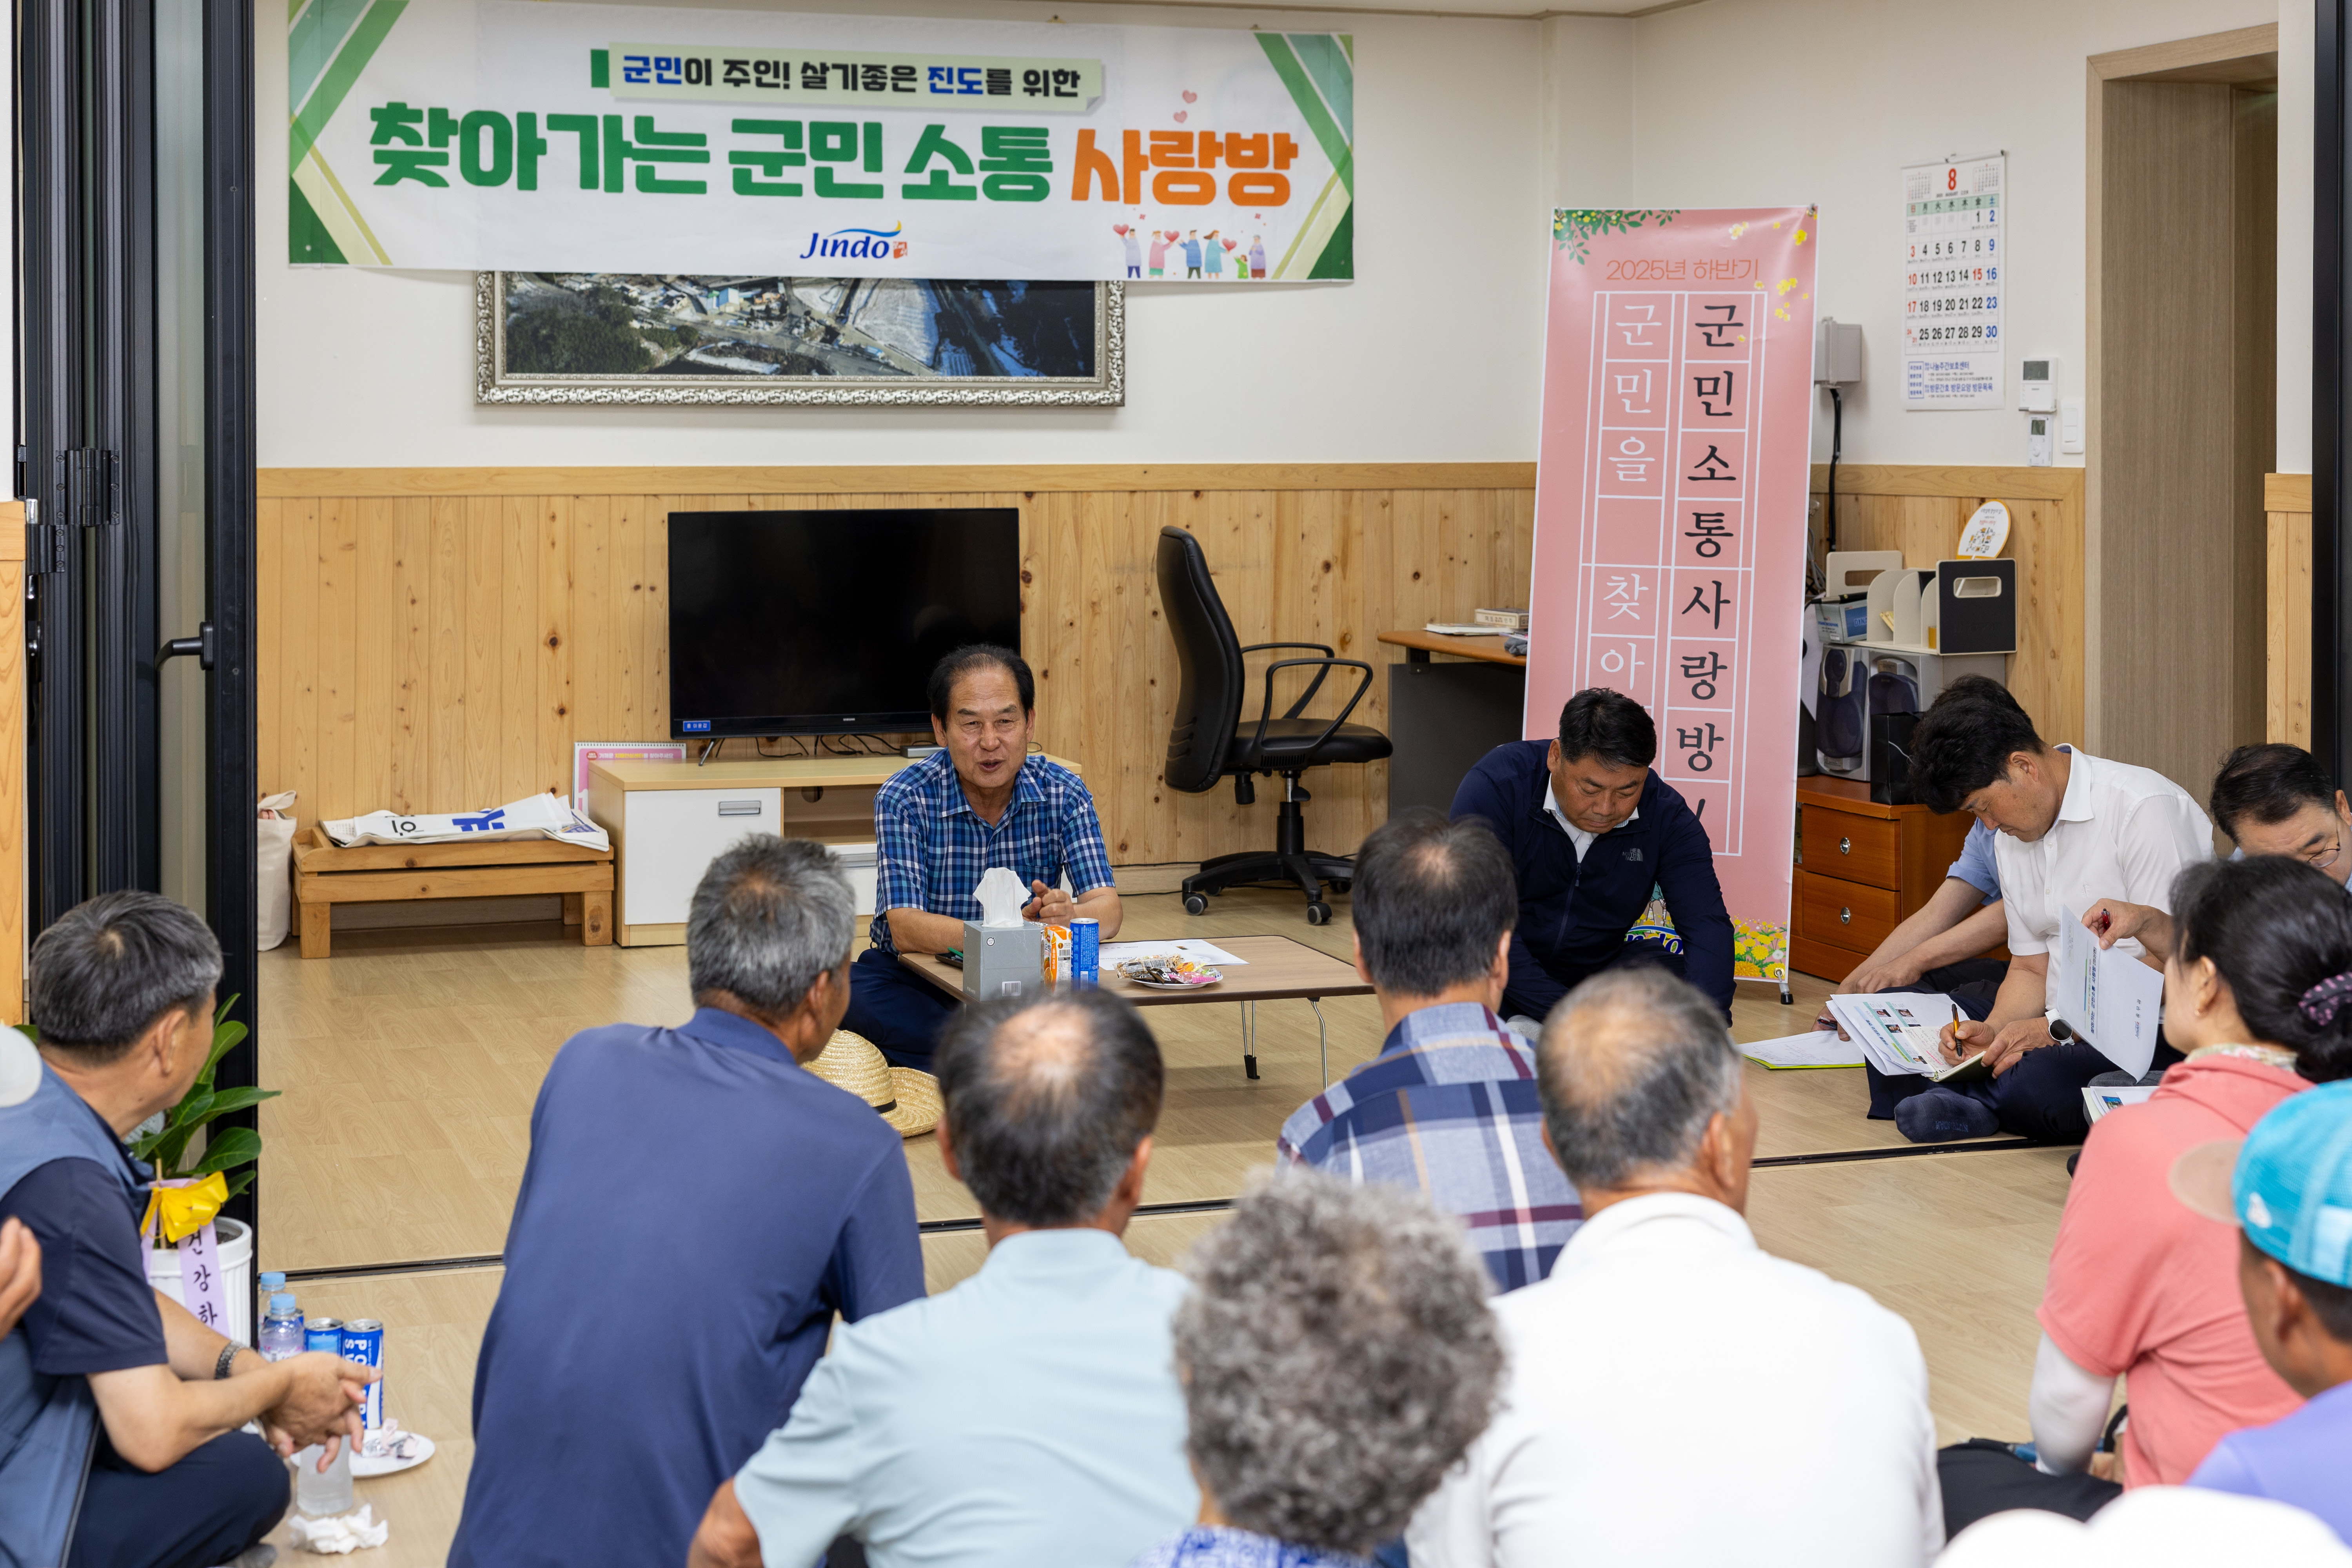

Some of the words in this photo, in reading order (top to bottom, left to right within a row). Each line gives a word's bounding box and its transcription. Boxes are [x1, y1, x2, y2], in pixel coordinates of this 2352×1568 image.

[623, 56, 712, 86] 군민이
[722, 59, 790, 90] 주인!
[800, 61, 918, 93] 살기좋은
[927, 66, 1013, 96] 진도를
[1023, 68, 1081, 98] 위한
[370, 102, 711, 195] 찾아가는
[728, 118, 884, 199] 군민
[901, 124, 1053, 202] 소통
[1071, 128, 1299, 207] 사랑방
[1948, 168, 1956, 191] 8
[1976, 211, 1980, 222] 1
[1990, 210, 1995, 222] 2
[800, 232, 889, 259] Jindo
[1911, 246, 1915, 257] 3
[1923, 245, 1927, 255] 4
[1936, 243, 1940, 255] 5
[1948, 242, 1953, 254] 6
[1962, 240, 1966, 252] 7
[1975, 240, 1980, 252] 8
[1989, 239, 1994, 251] 9
[1606, 260, 1686, 280] 2025년
[1693, 259, 1759, 280] 하반기
[1909, 273, 1916, 285] 10
[1921, 272, 1929, 283] 11
[1933, 271, 1942, 283] 12
[1946, 270, 1955, 282] 13
[1959, 269, 1969, 281] 14
[1973, 268, 1982, 280] 15
[1987, 267, 1997, 279] 16
[1908, 301, 1916, 312] 17
[1920, 300, 1929, 312] 18
[1933, 299, 1942, 311] 19
[1945, 299, 1955, 310] 20
[1959, 298, 1968, 310] 21
[1972, 297, 1982, 309] 22
[1987, 296, 1997, 309] 23
[1920, 328, 1929, 340] 25
[1933, 328, 1942, 339] 26
[1945, 327, 1955, 339] 27
[1958, 327, 1968, 338] 28
[1972, 326, 1982, 338] 29
[1986, 326, 1997, 338] 30
[1608, 305, 1662, 482] 군민을
[1600, 573, 1649, 690] 찾아
